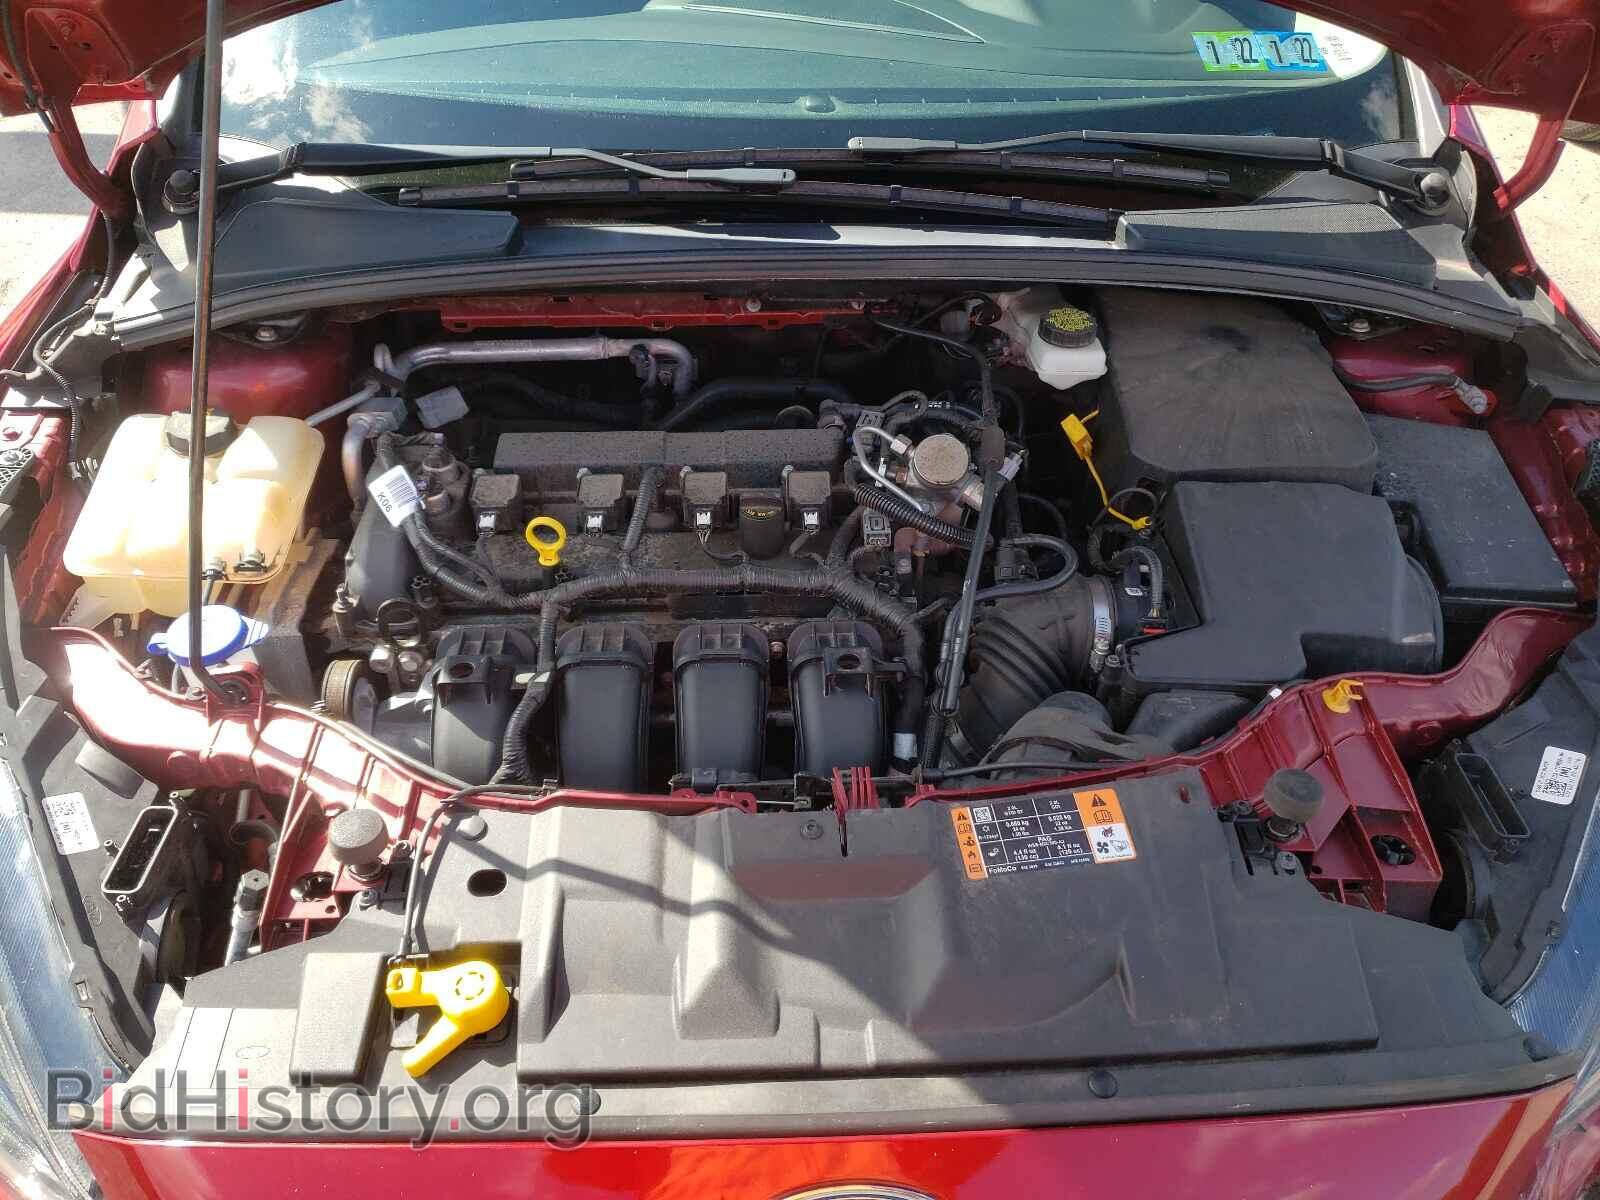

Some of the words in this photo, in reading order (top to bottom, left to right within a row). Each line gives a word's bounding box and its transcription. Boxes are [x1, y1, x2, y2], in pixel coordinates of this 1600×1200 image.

[1232, 37, 1259, 64] 22
[1292, 37, 1319, 64] 22
[376, 492, 393, 513] K06
[989, 866, 1017, 874] FoMoCo
